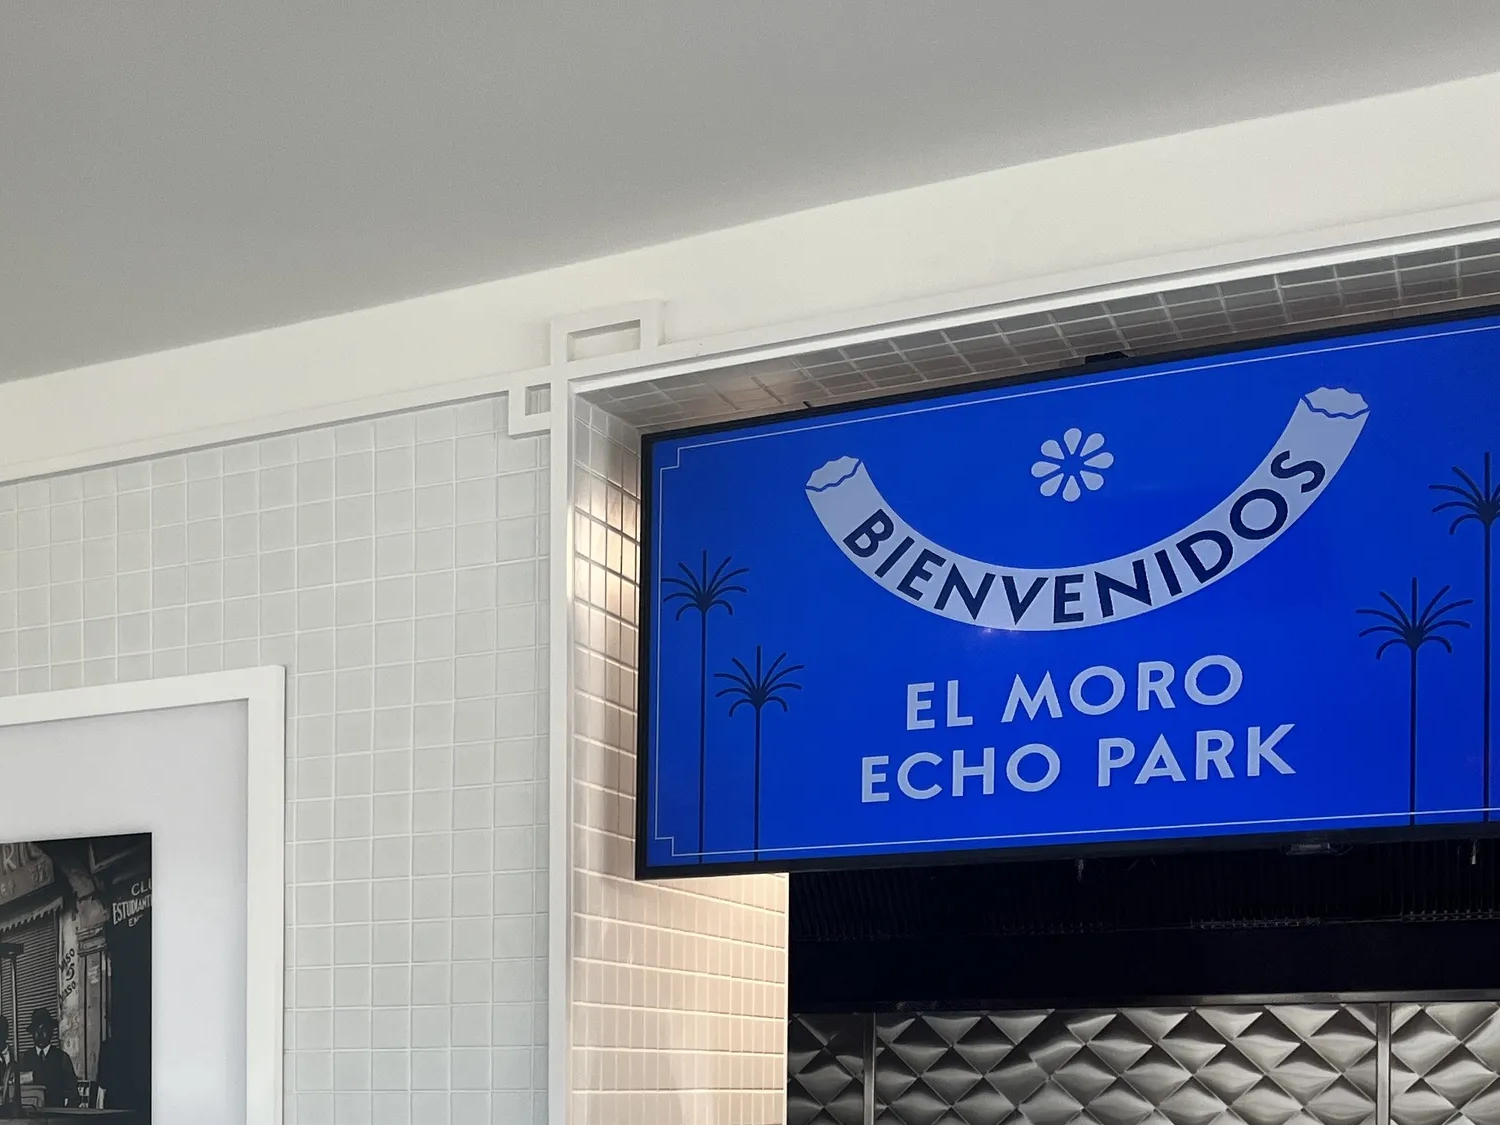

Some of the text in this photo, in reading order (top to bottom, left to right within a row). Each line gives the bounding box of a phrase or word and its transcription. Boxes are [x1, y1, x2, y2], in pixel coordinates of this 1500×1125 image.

[842, 450, 1326, 626] BIENVENIDOS
[906, 654, 1244, 732] EL MORO
[861, 723, 1297, 803] ECHO PARK
[112, 894, 152, 926] ESTUDIANT
